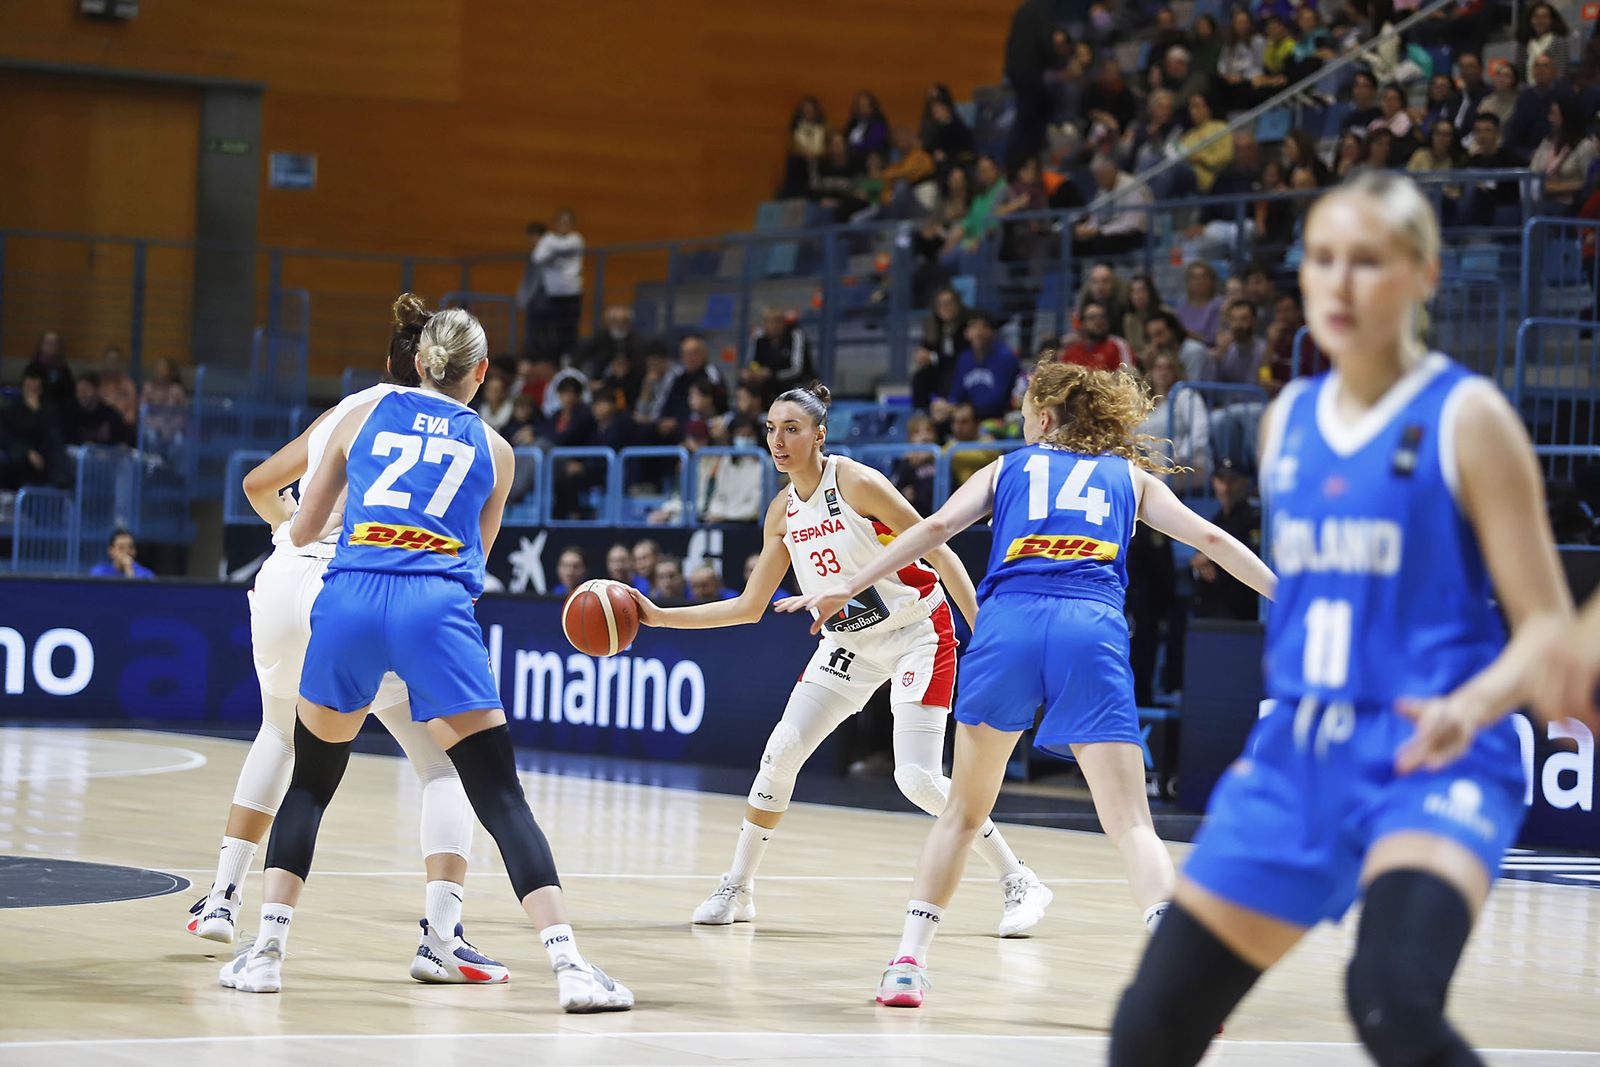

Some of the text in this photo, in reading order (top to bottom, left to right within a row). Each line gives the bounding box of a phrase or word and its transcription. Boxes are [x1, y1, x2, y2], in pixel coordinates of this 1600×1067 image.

[412, 412, 449, 436] EVA
[363, 431, 476, 518] 27
[1023, 454, 1111, 526] 14
[363, 525, 456, 553] DHL
[791, 519, 845, 543] ESPAÑA
[1018, 538, 1103, 558] DHL
[809, 548, 842, 577] 33
[834, 611, 883, 633] CaixaBank
[819, 664, 851, 682] network
[828, 647, 856, 673] fi
[513, 648, 706, 735] marino
